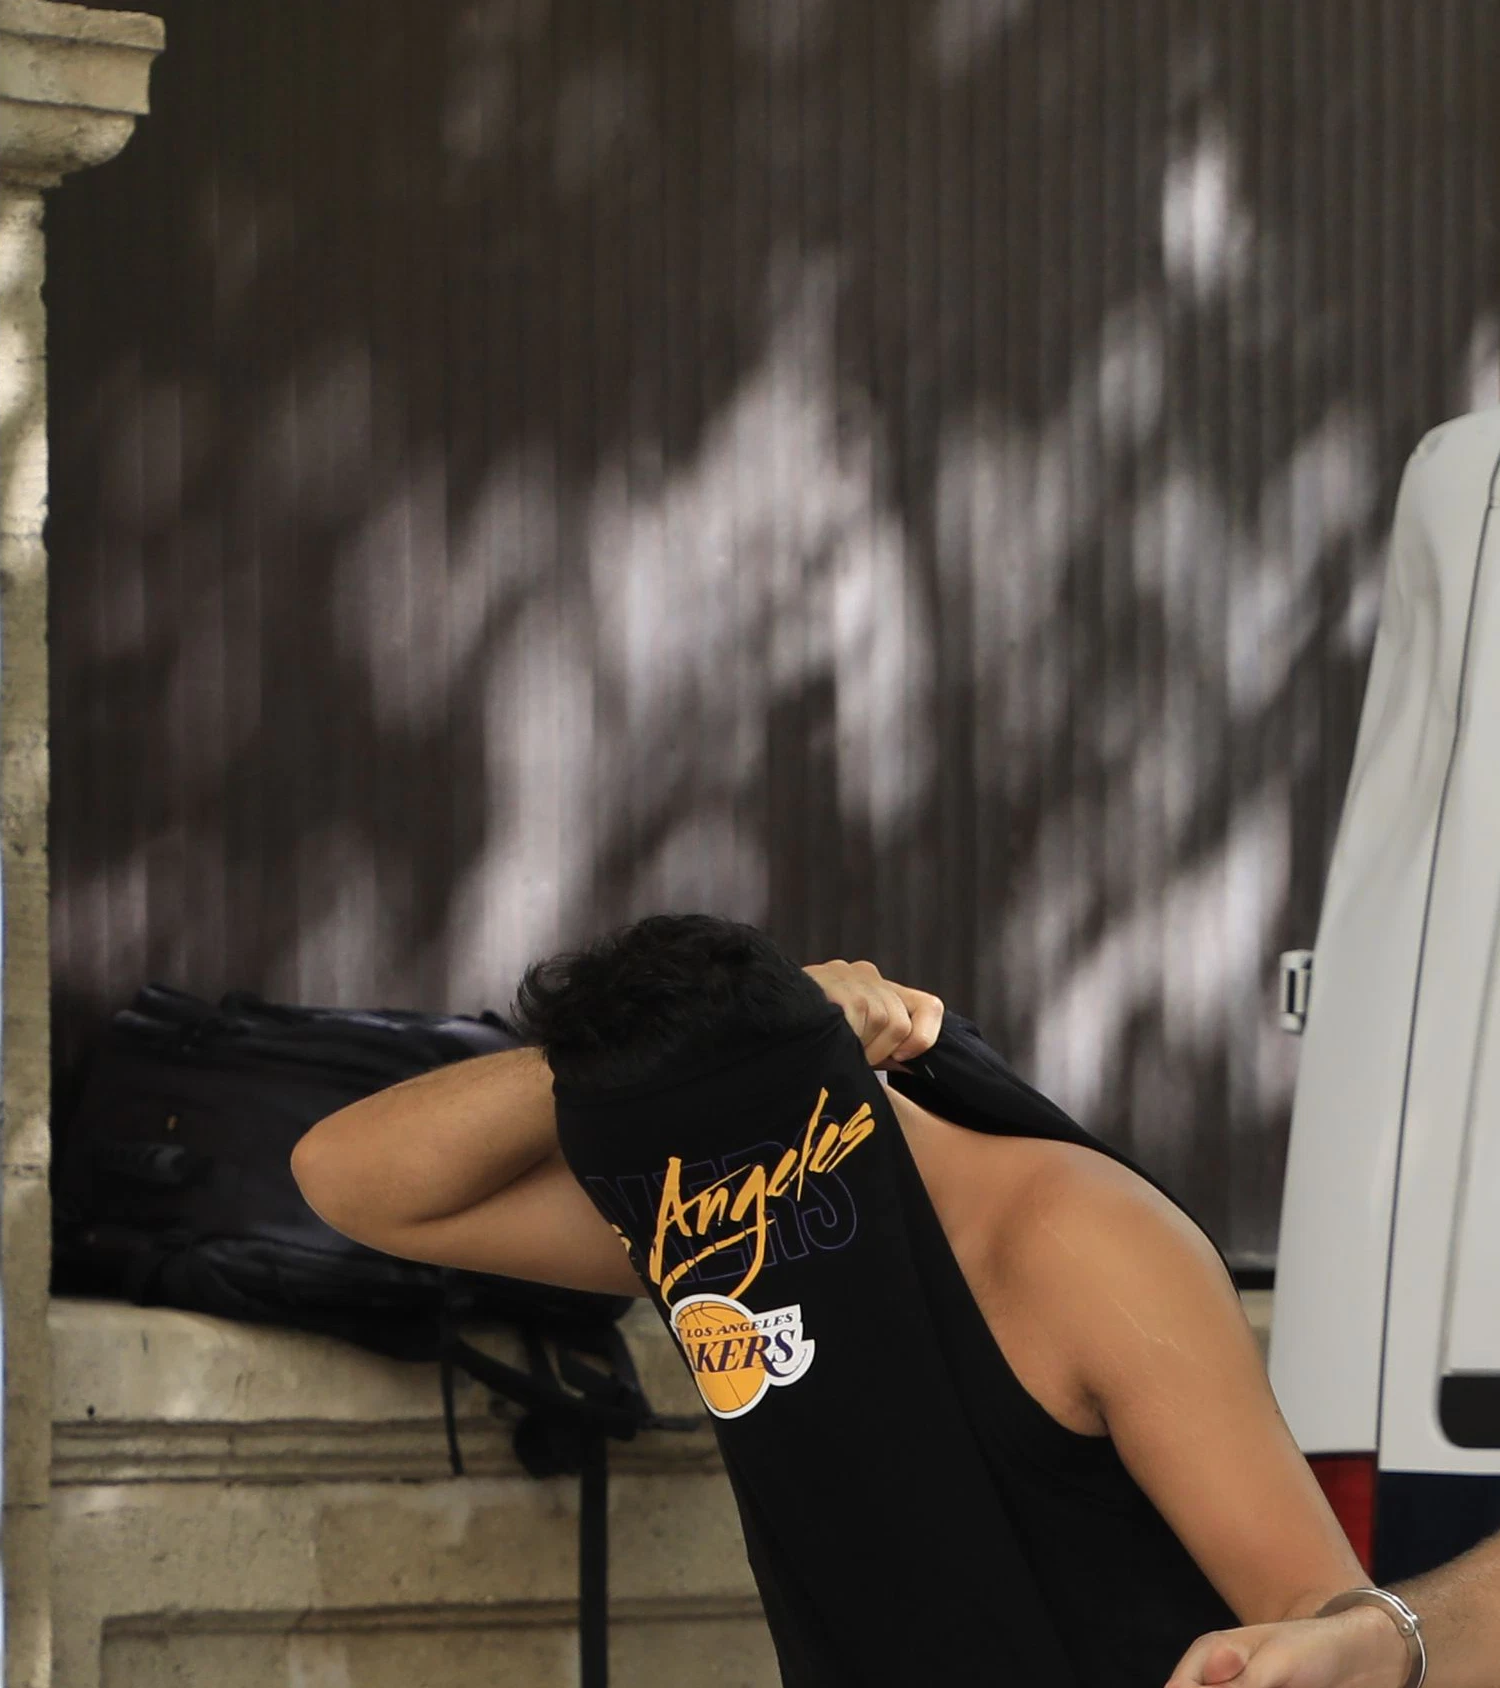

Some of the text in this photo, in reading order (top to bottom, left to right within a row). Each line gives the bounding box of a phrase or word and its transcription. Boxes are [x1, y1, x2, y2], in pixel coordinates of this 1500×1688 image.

[649, 1087, 875, 1301] Angeles
[687, 1312, 794, 1338] LOS ANGELES
